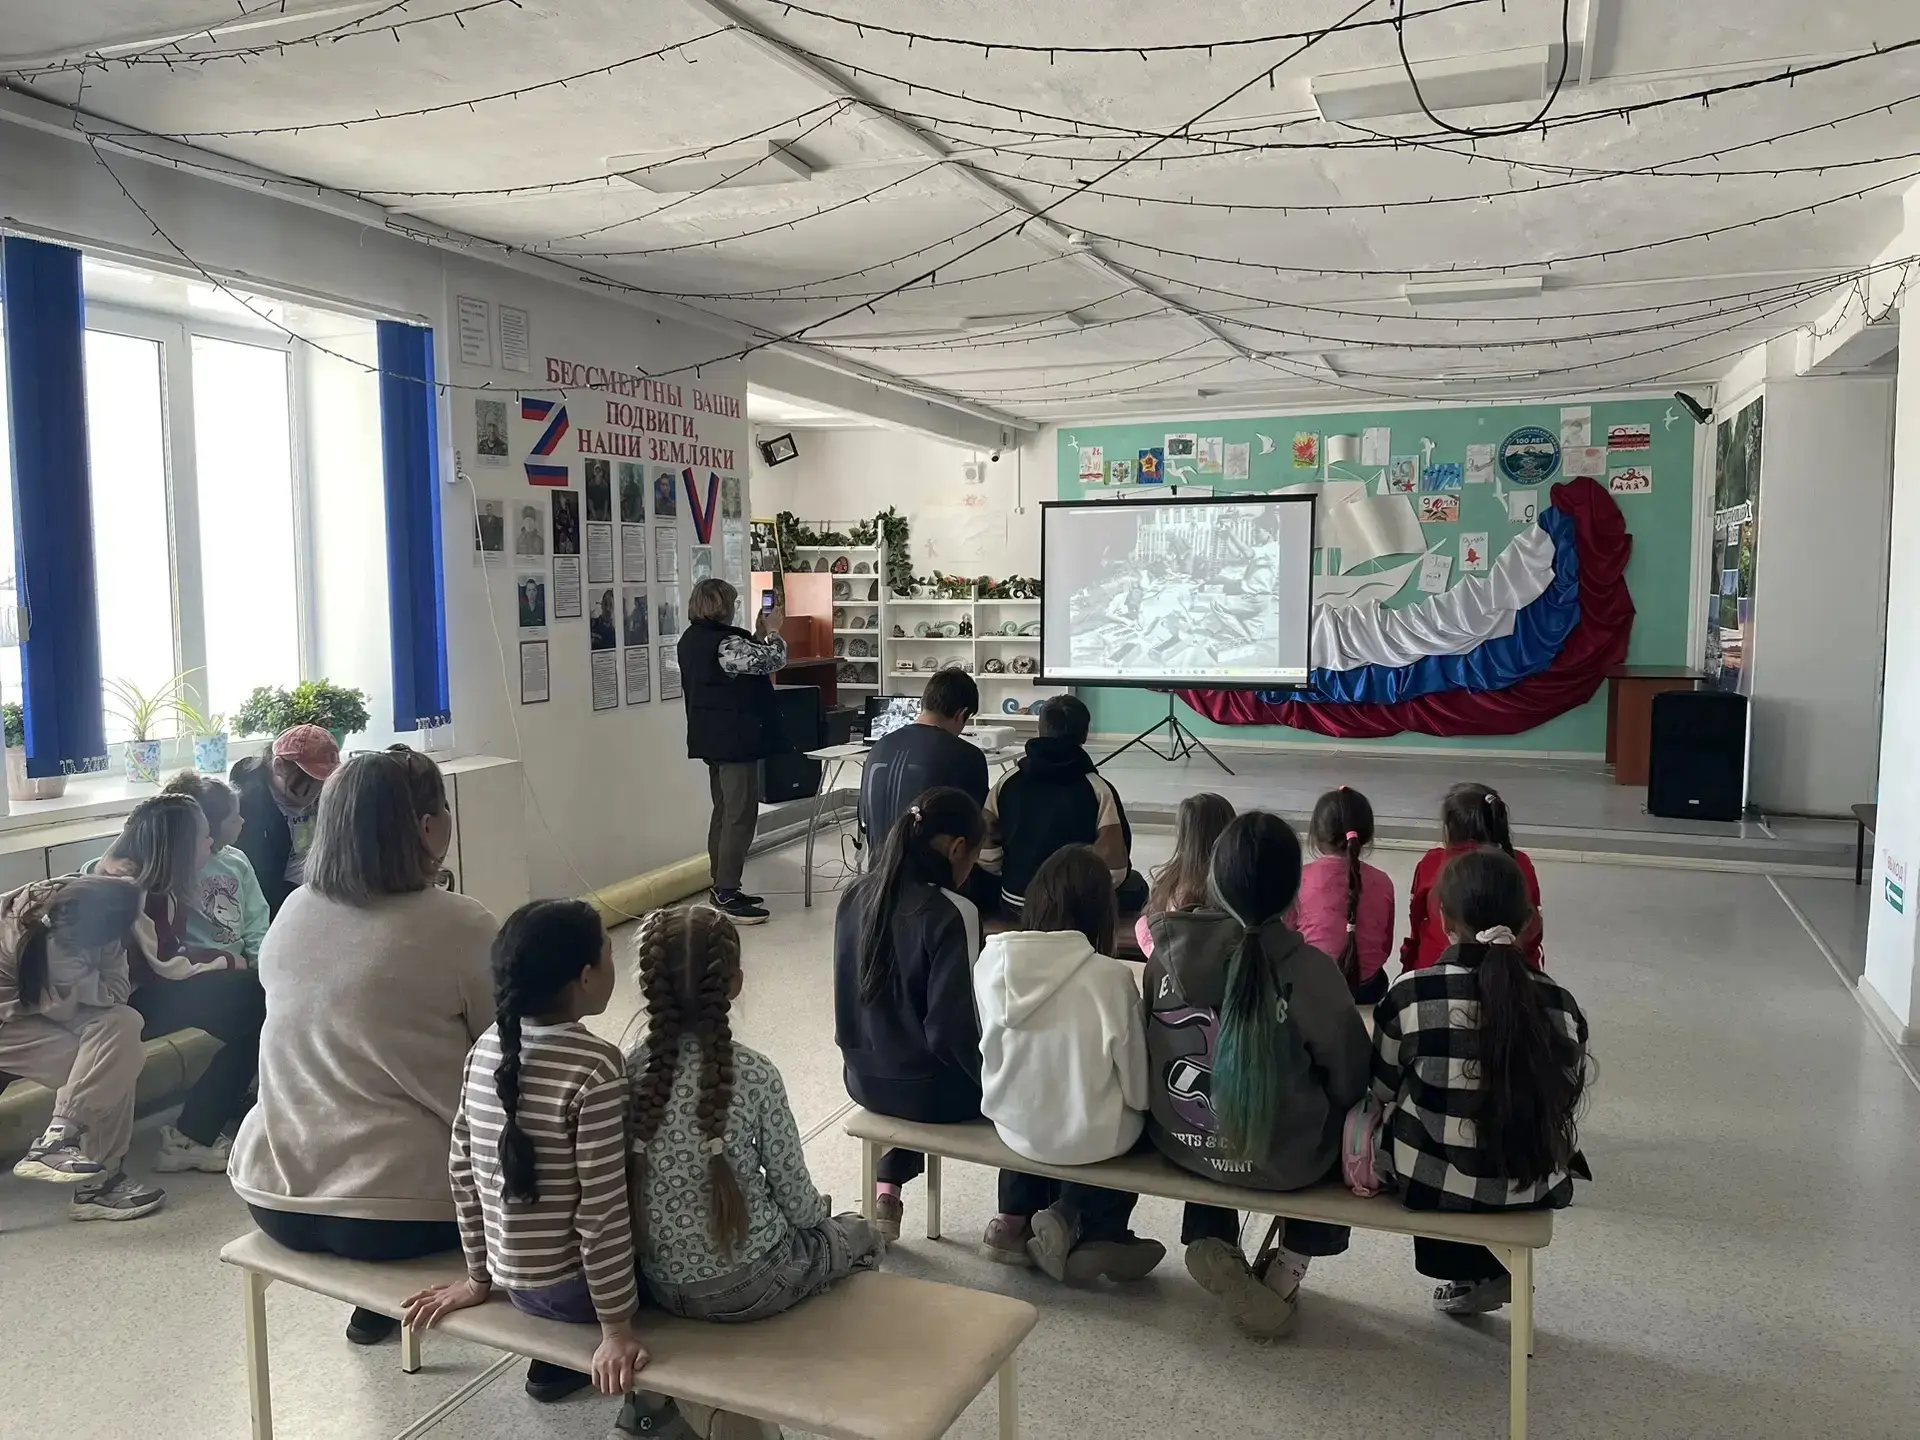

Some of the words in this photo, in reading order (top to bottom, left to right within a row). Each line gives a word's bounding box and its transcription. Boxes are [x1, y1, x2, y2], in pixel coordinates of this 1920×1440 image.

[545, 357, 683, 408] БЕССМЕРТНЫ
[692, 388, 742, 419] ВАШИ
[606, 400, 699, 443] ПОДВИГИ,
[577, 428, 642, 459] НАШИ
[648, 437, 735, 470] ЗЕМЛЯКИ
[1423, 497, 1431, 509] 9
[1524, 504, 1535, 523] 9
[1463, 537, 1471, 548] 9
[1210, 1158, 1254, 1172] WANT
